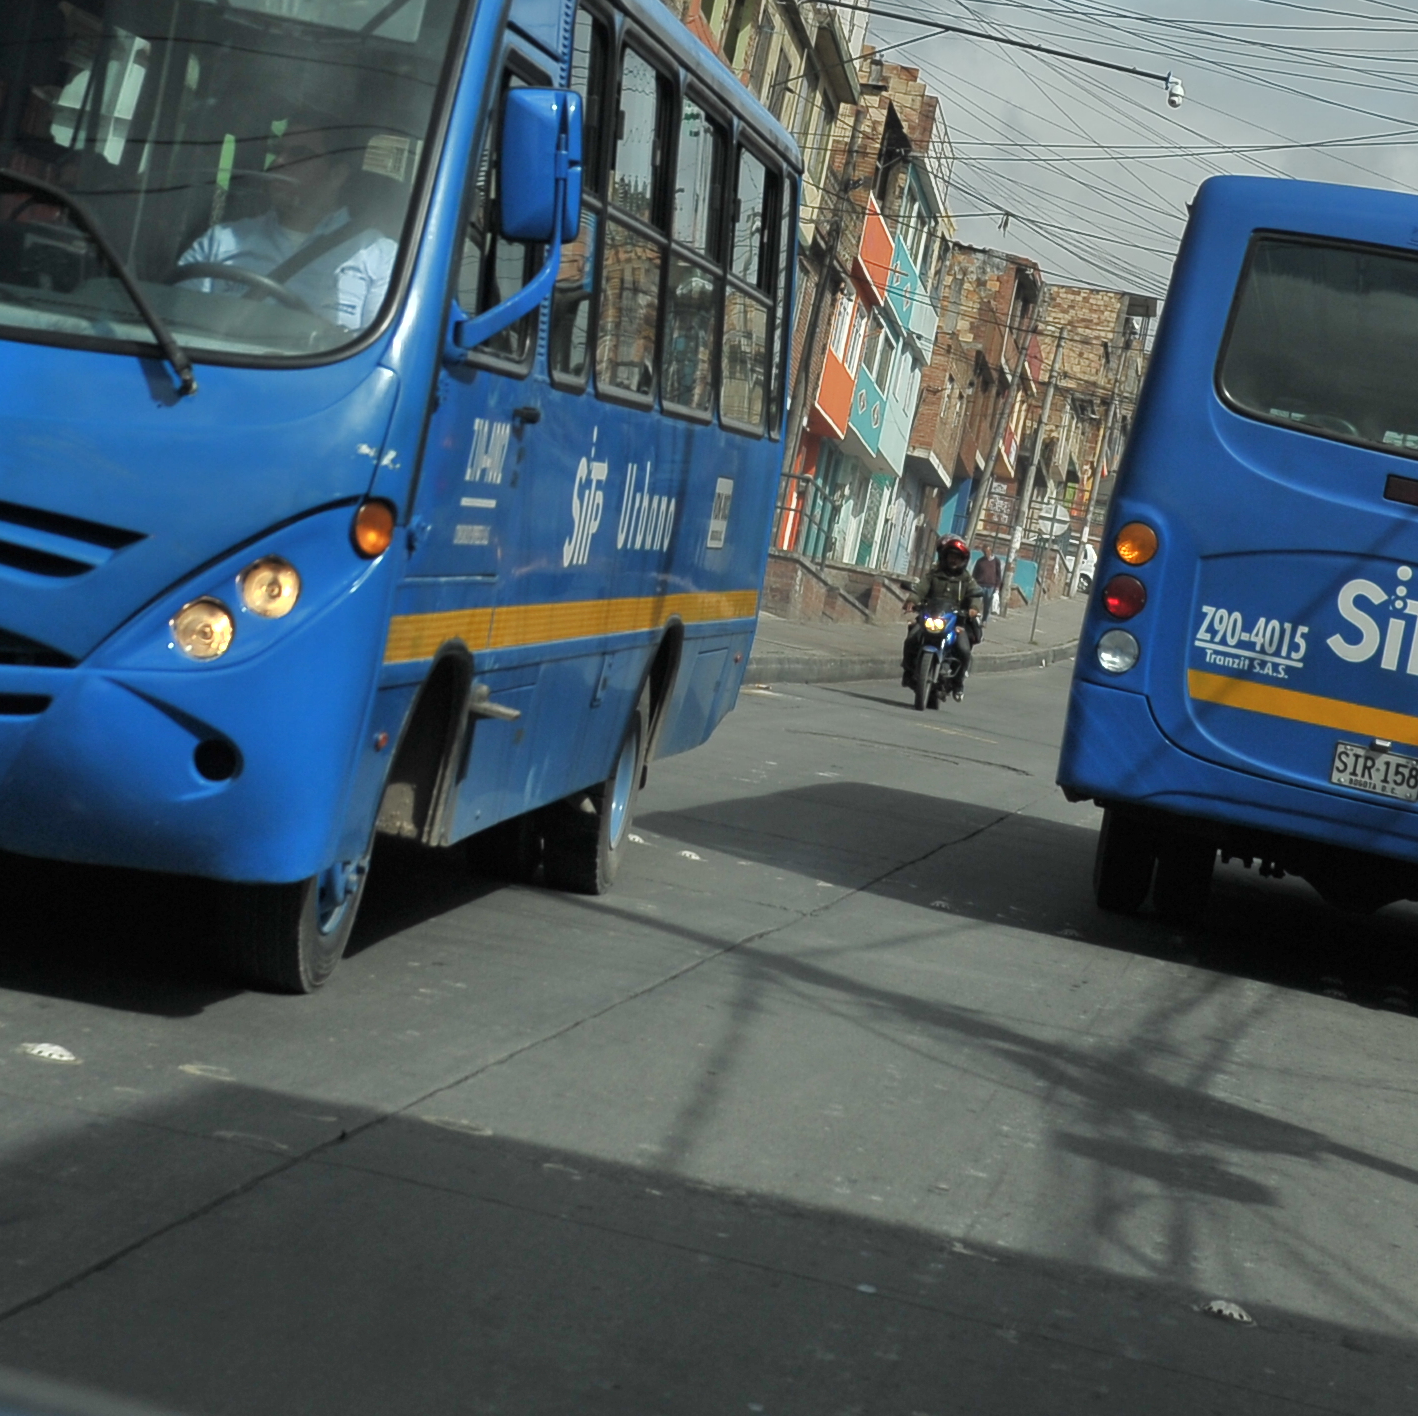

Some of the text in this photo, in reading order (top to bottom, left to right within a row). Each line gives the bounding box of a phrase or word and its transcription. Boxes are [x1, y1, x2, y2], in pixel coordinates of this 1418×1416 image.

[617, 460, 676, 553] Urbano
[1196, 605, 1309, 660] Z90-4015
[1205, 649, 1289, 679] Tranzit S.A.S.
